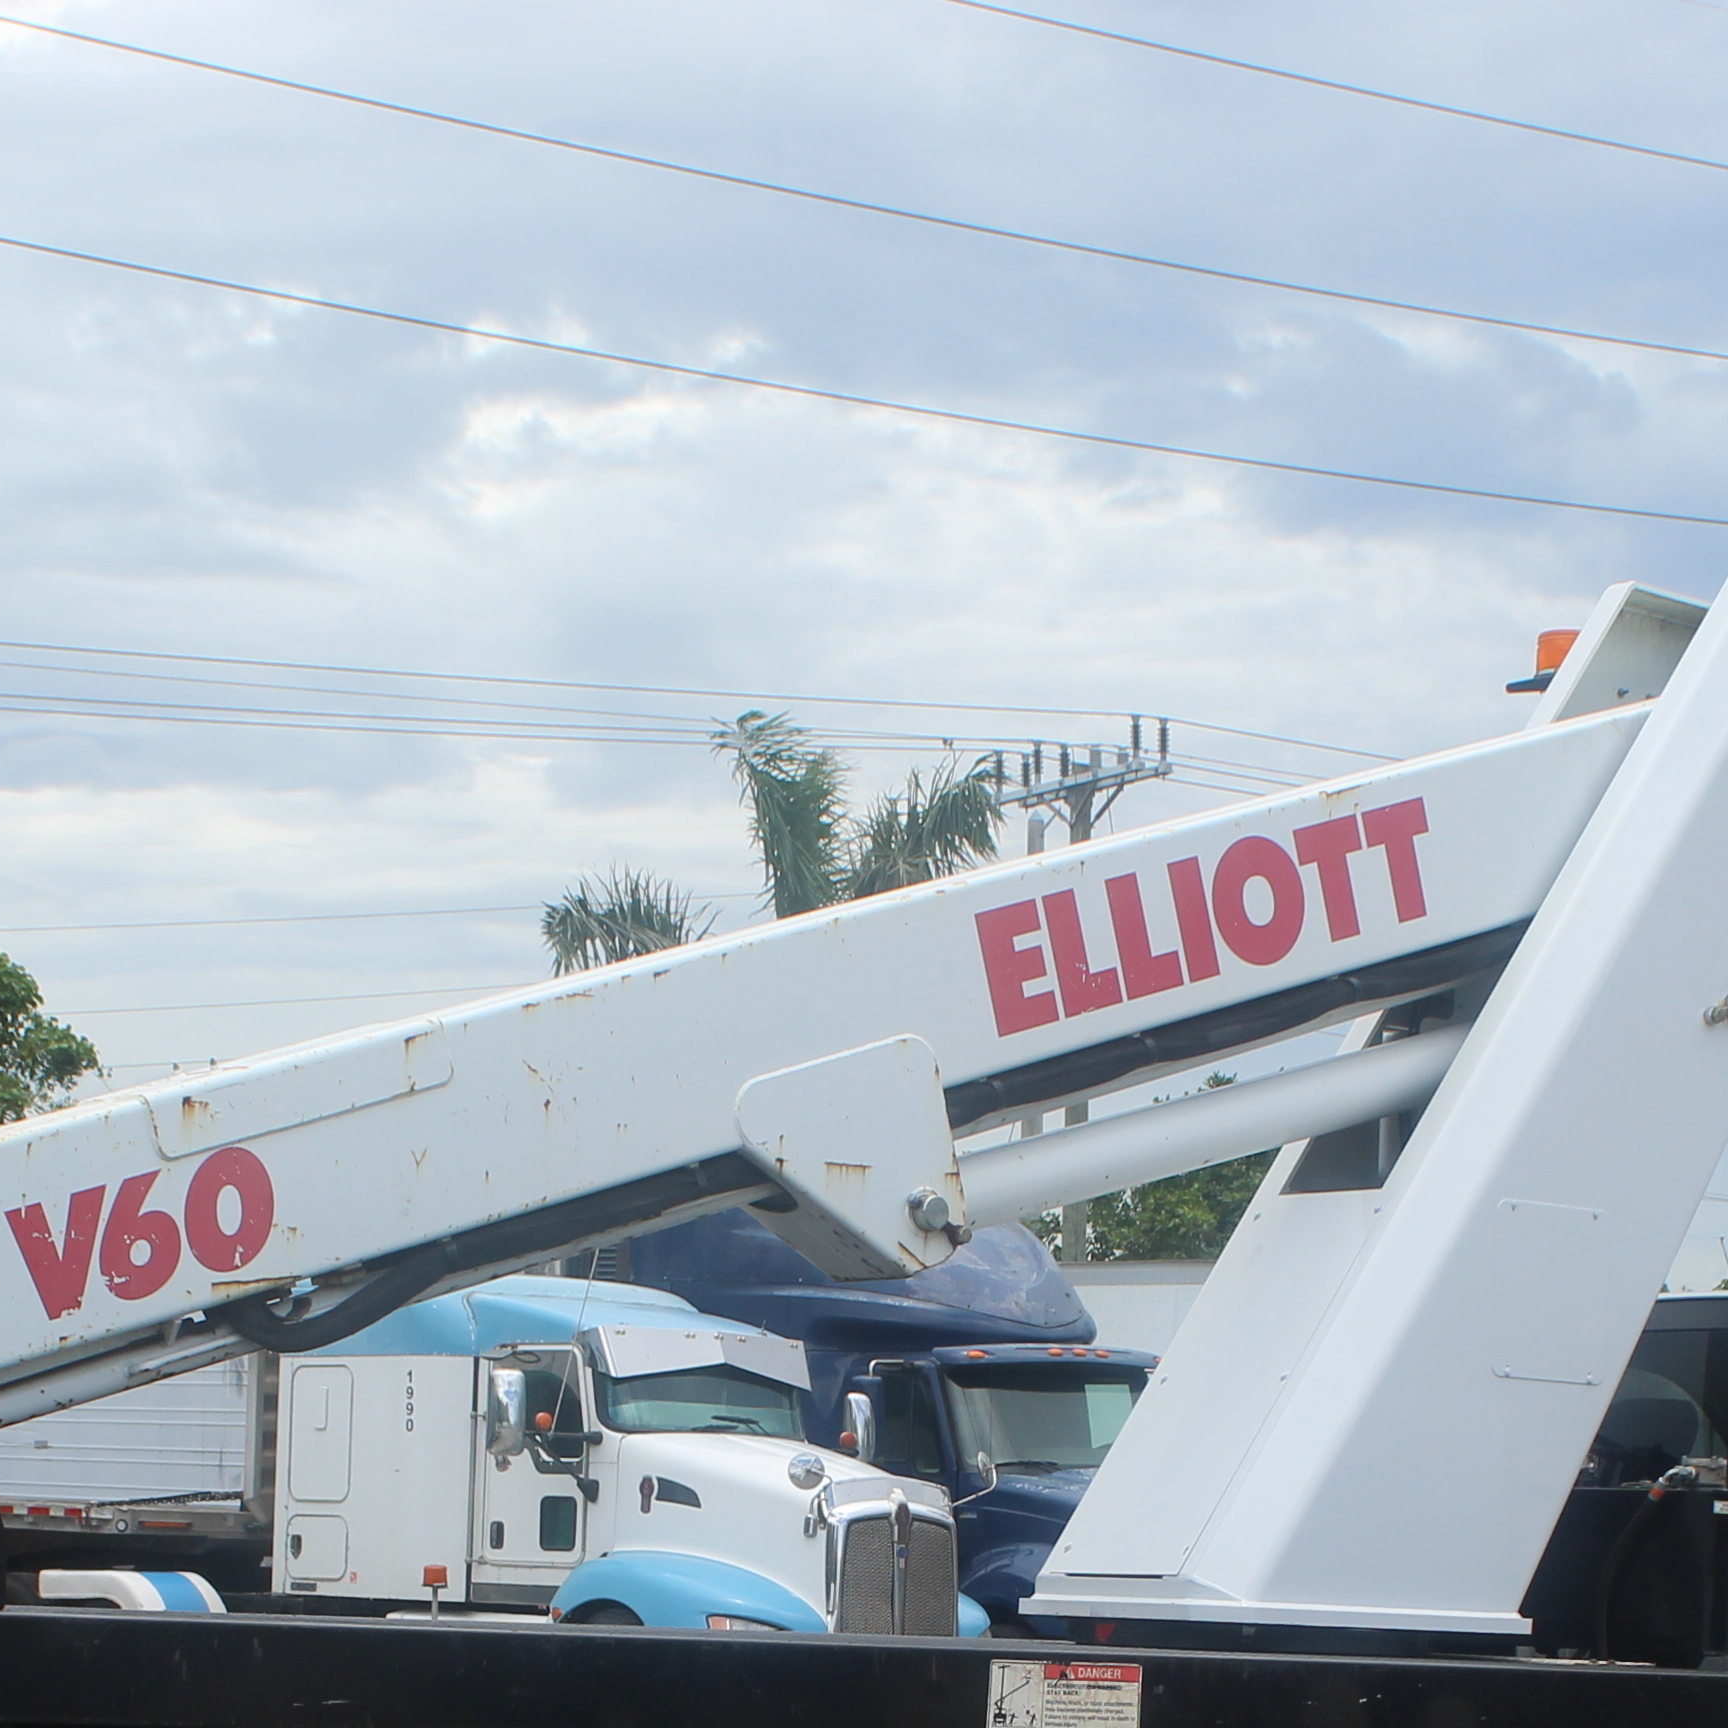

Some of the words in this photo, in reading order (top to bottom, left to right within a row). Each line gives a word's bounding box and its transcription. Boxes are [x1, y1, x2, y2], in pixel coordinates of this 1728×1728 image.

[974, 797, 1429, 1037] ELLIOTT
[4, 1146, 275, 1320] V60
[405, 1369, 414, 1433] 1990
[1078, 1667, 1122, 1679] DANGER
